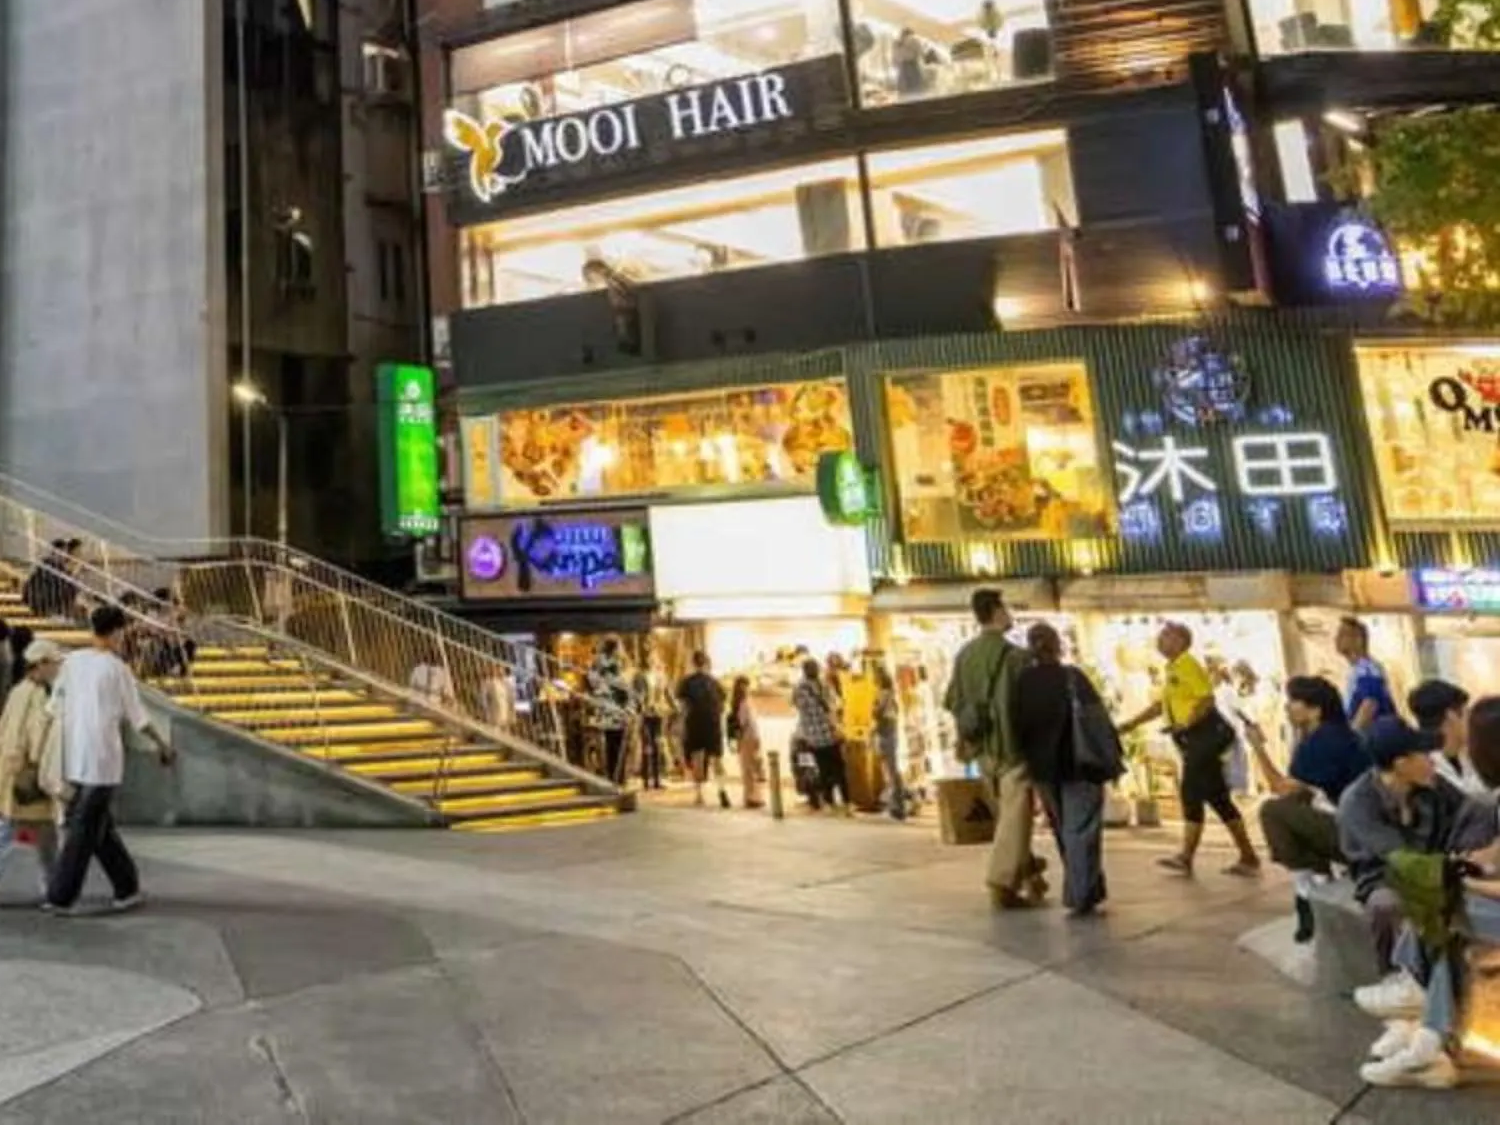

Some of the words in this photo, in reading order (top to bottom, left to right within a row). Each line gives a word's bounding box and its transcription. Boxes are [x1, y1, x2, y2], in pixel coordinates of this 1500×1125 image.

[521, 105, 641, 171] MOOI
[665, 72, 793, 140] HAIR
[1112, 432, 1338, 504] 沐田
